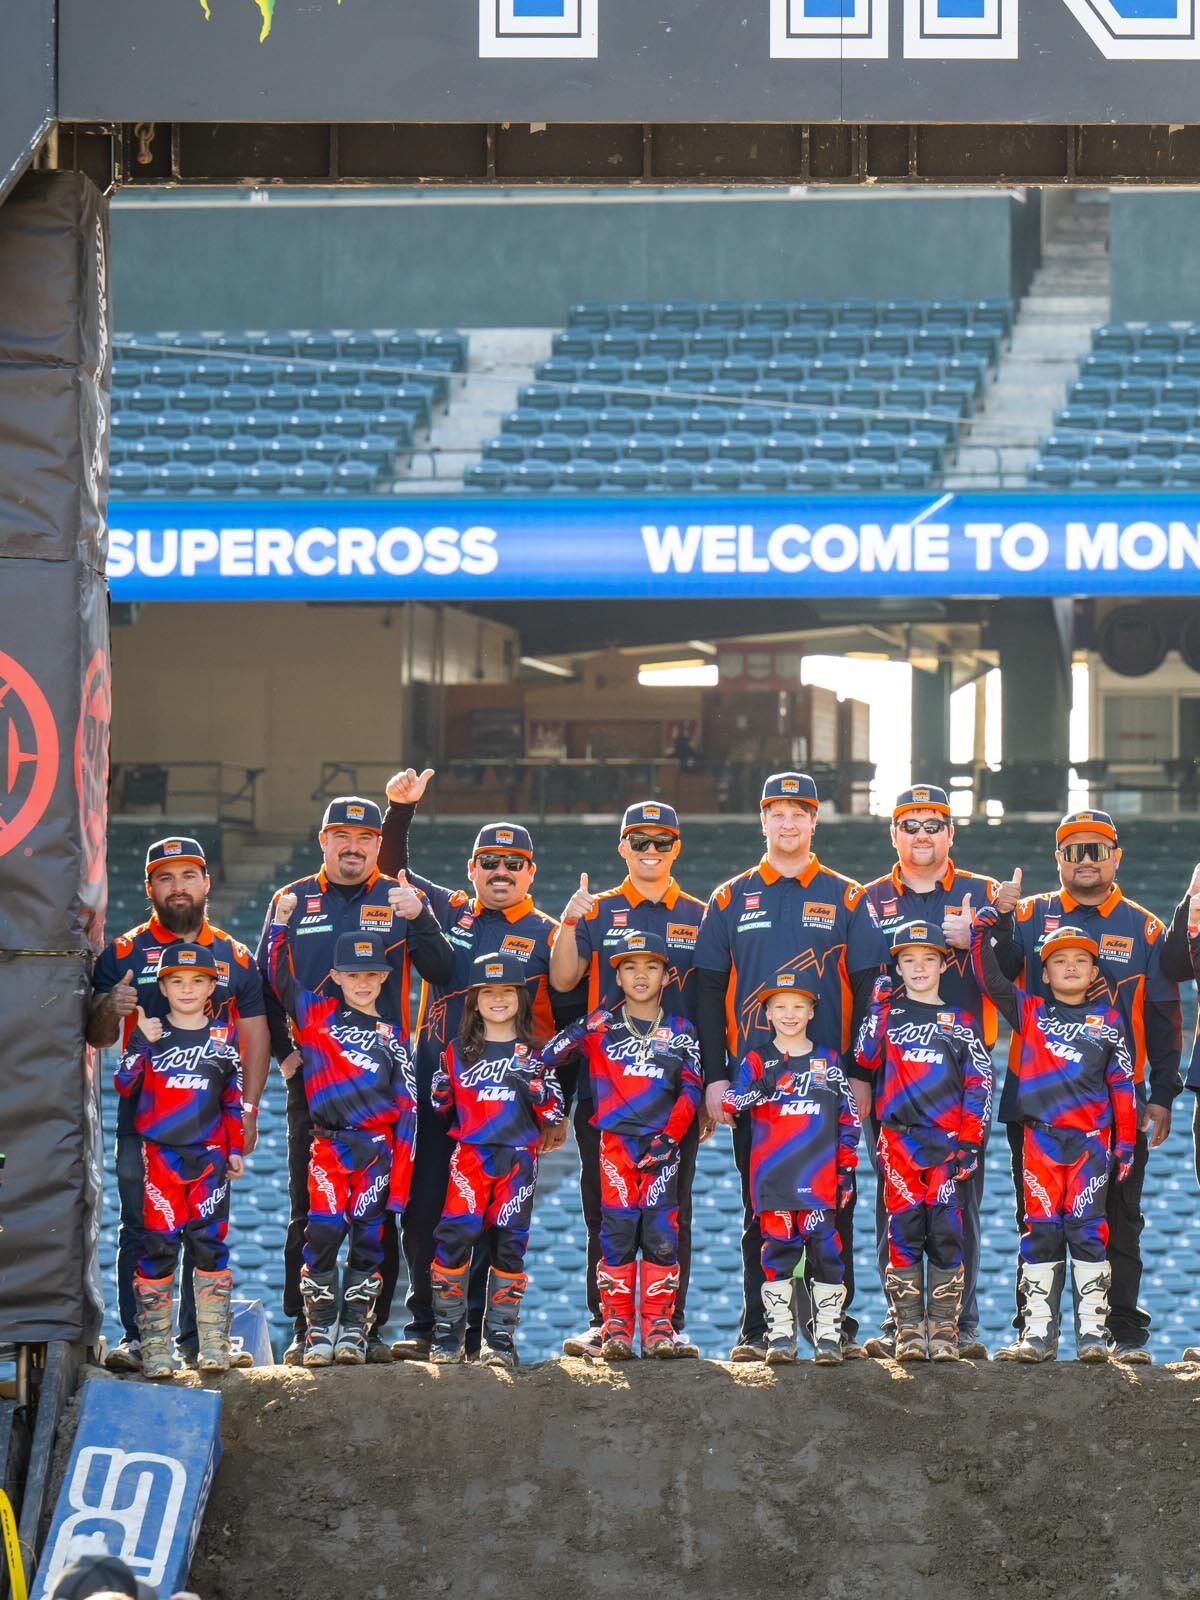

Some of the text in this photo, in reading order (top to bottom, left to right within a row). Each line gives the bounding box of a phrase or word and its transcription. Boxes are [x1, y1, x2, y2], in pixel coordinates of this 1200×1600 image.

[106, 527, 499, 577] SUPERCROSS
[641, 524, 950, 573] WELCOME
[964, 523, 1050, 571] TO
[810, 907, 830, 916] KTM
[507, 940, 529, 950] KTM
[902, 1048, 943, 1064] KTM
[1045, 1041, 1083, 1063] KTM
[339, 1049, 380, 1073] KTM
[623, 1063, 664, 1079] KTM
[166, 1074, 209, 1090] KTM
[477, 1086, 516, 1102] KTM
[780, 1100, 820, 1116] KTM
